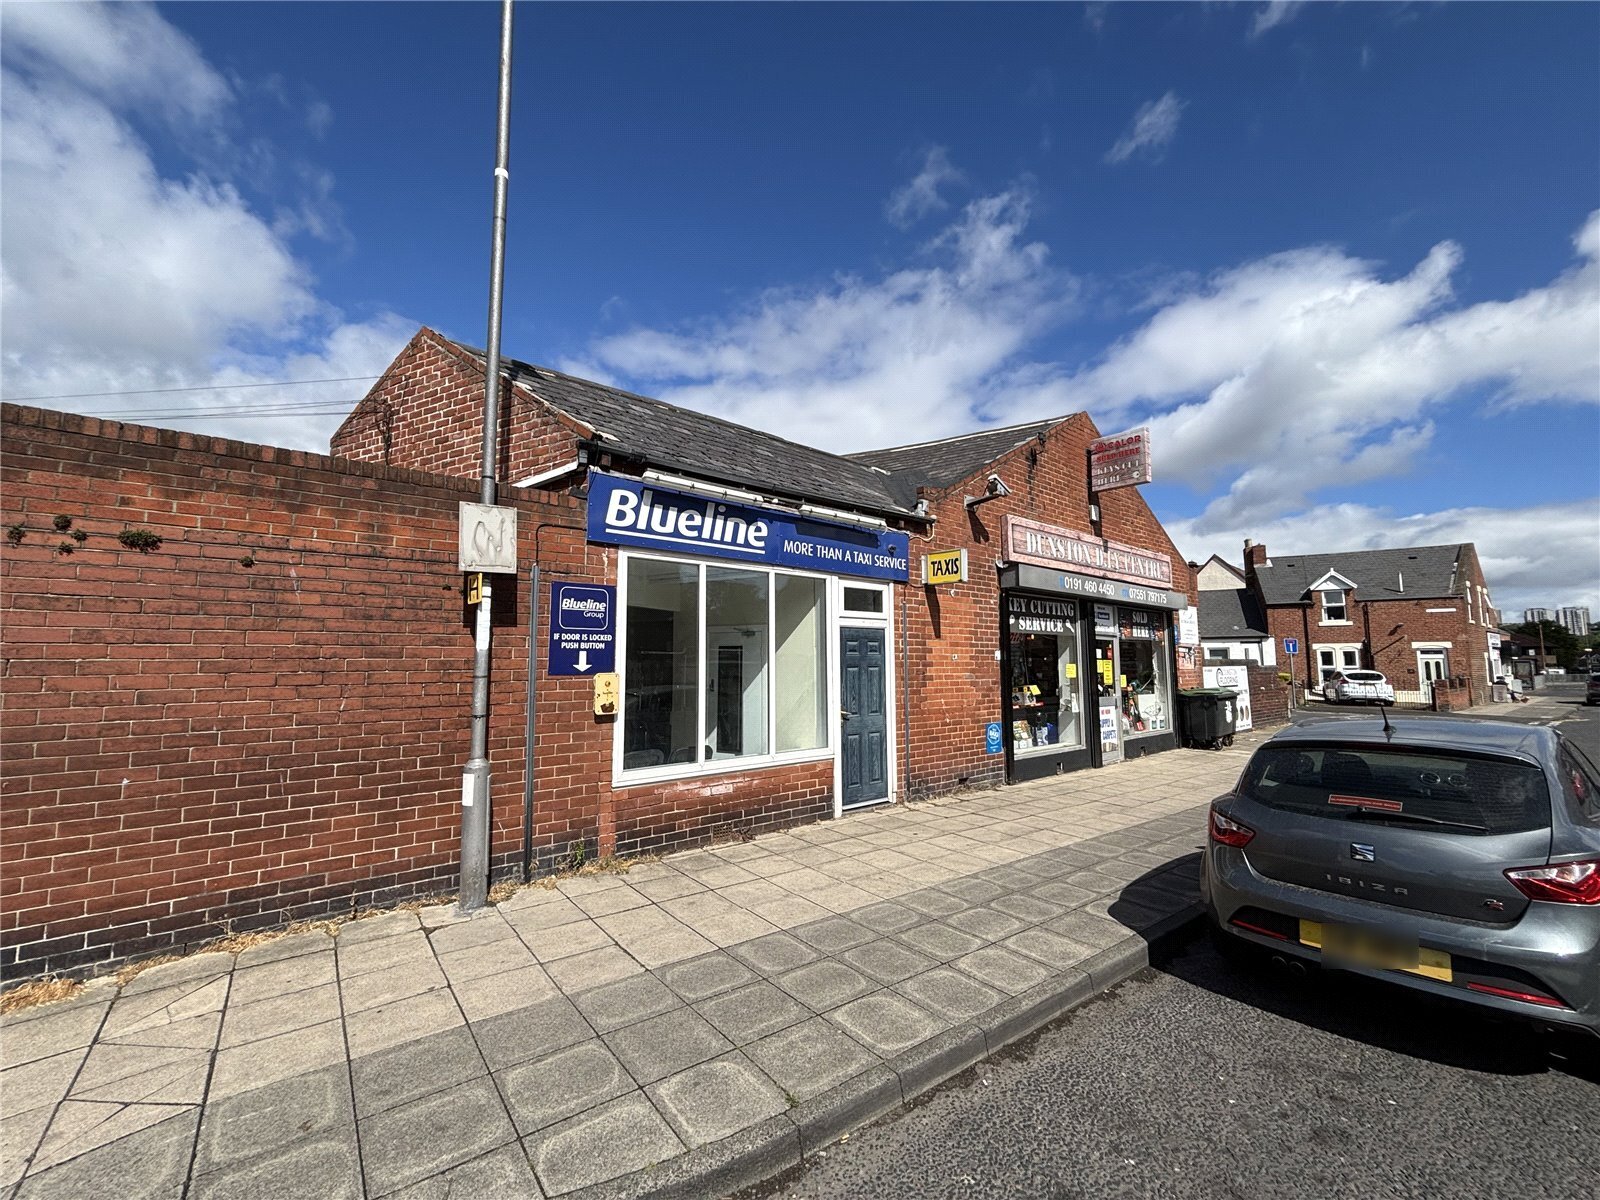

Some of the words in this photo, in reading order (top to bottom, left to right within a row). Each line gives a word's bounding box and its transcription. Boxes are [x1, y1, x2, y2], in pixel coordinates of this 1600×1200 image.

[1106, 434, 1142, 450] CALOR
[605, 489, 768, 547] Blueline
[783, 539, 814, 557] MORE
[816, 545, 842, 561] THAN
[844, 550, 852, 562] A
[853, 551, 872, 566] TAXI
[874, 554, 907, 571] SERVICE
[1026, 531, 1091, 565] DUNSTON
[1124, 554, 1164, 580] CENTRE
[930, 557, 960, 577] TAXIS
[469, 576, 479, 602] H
[1064, 576, 1083, 591] 0191
[1083, 580, 1098, 593] 460
[1098, 582, 1115, 596] 4450
[561, 597, 607, 611] Blueline
[1128, 587, 1147, 600] 07551
[1147, 590, 1168, 604] 797175
[583, 610, 605, 620] Group
[1030, 599, 1074, 617] CUTTING
[1018, 615, 1064, 633] SERVICE
[1132, 611, 1148, 624] SOLD
[589, 634, 613, 642] LOCKED
[1132, 625, 1150, 638] HERE
[1326, 873, 1408, 896] IBIZA
